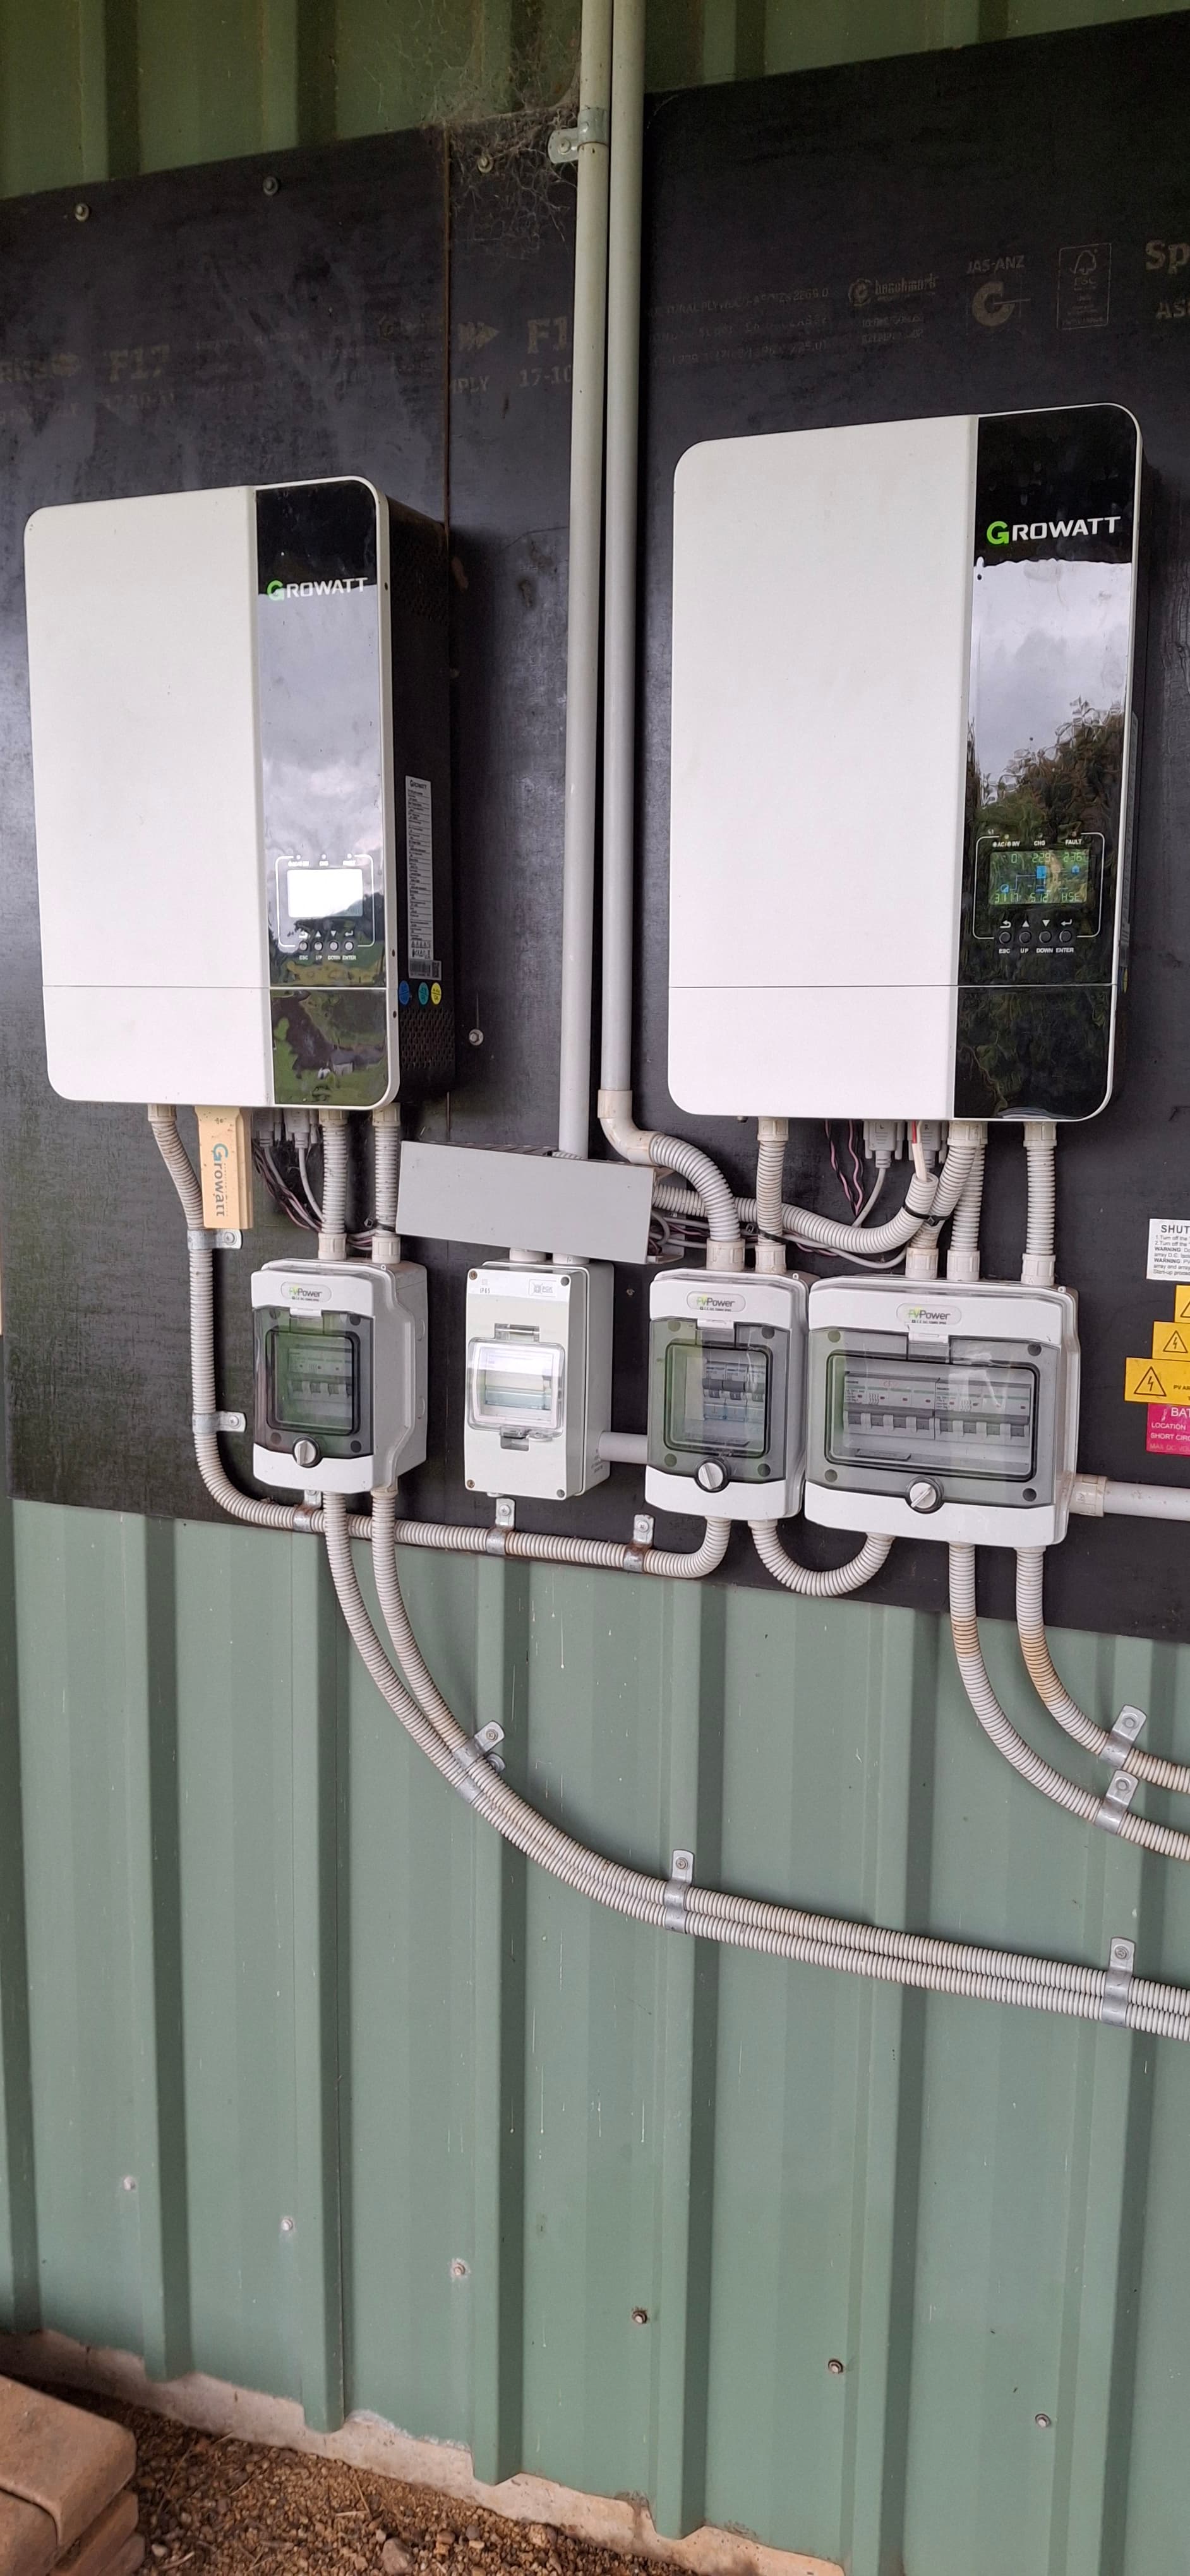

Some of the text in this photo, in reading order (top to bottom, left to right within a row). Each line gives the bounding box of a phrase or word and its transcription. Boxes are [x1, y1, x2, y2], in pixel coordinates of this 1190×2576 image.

[987, 516, 1121, 545] GROWATT
[267, 577, 368, 601] GROWATT
[1032, 852, 1051, 864] 229
[1063, 852, 1083, 863] 236
[213, 1143, 229, 1217] Growatt
